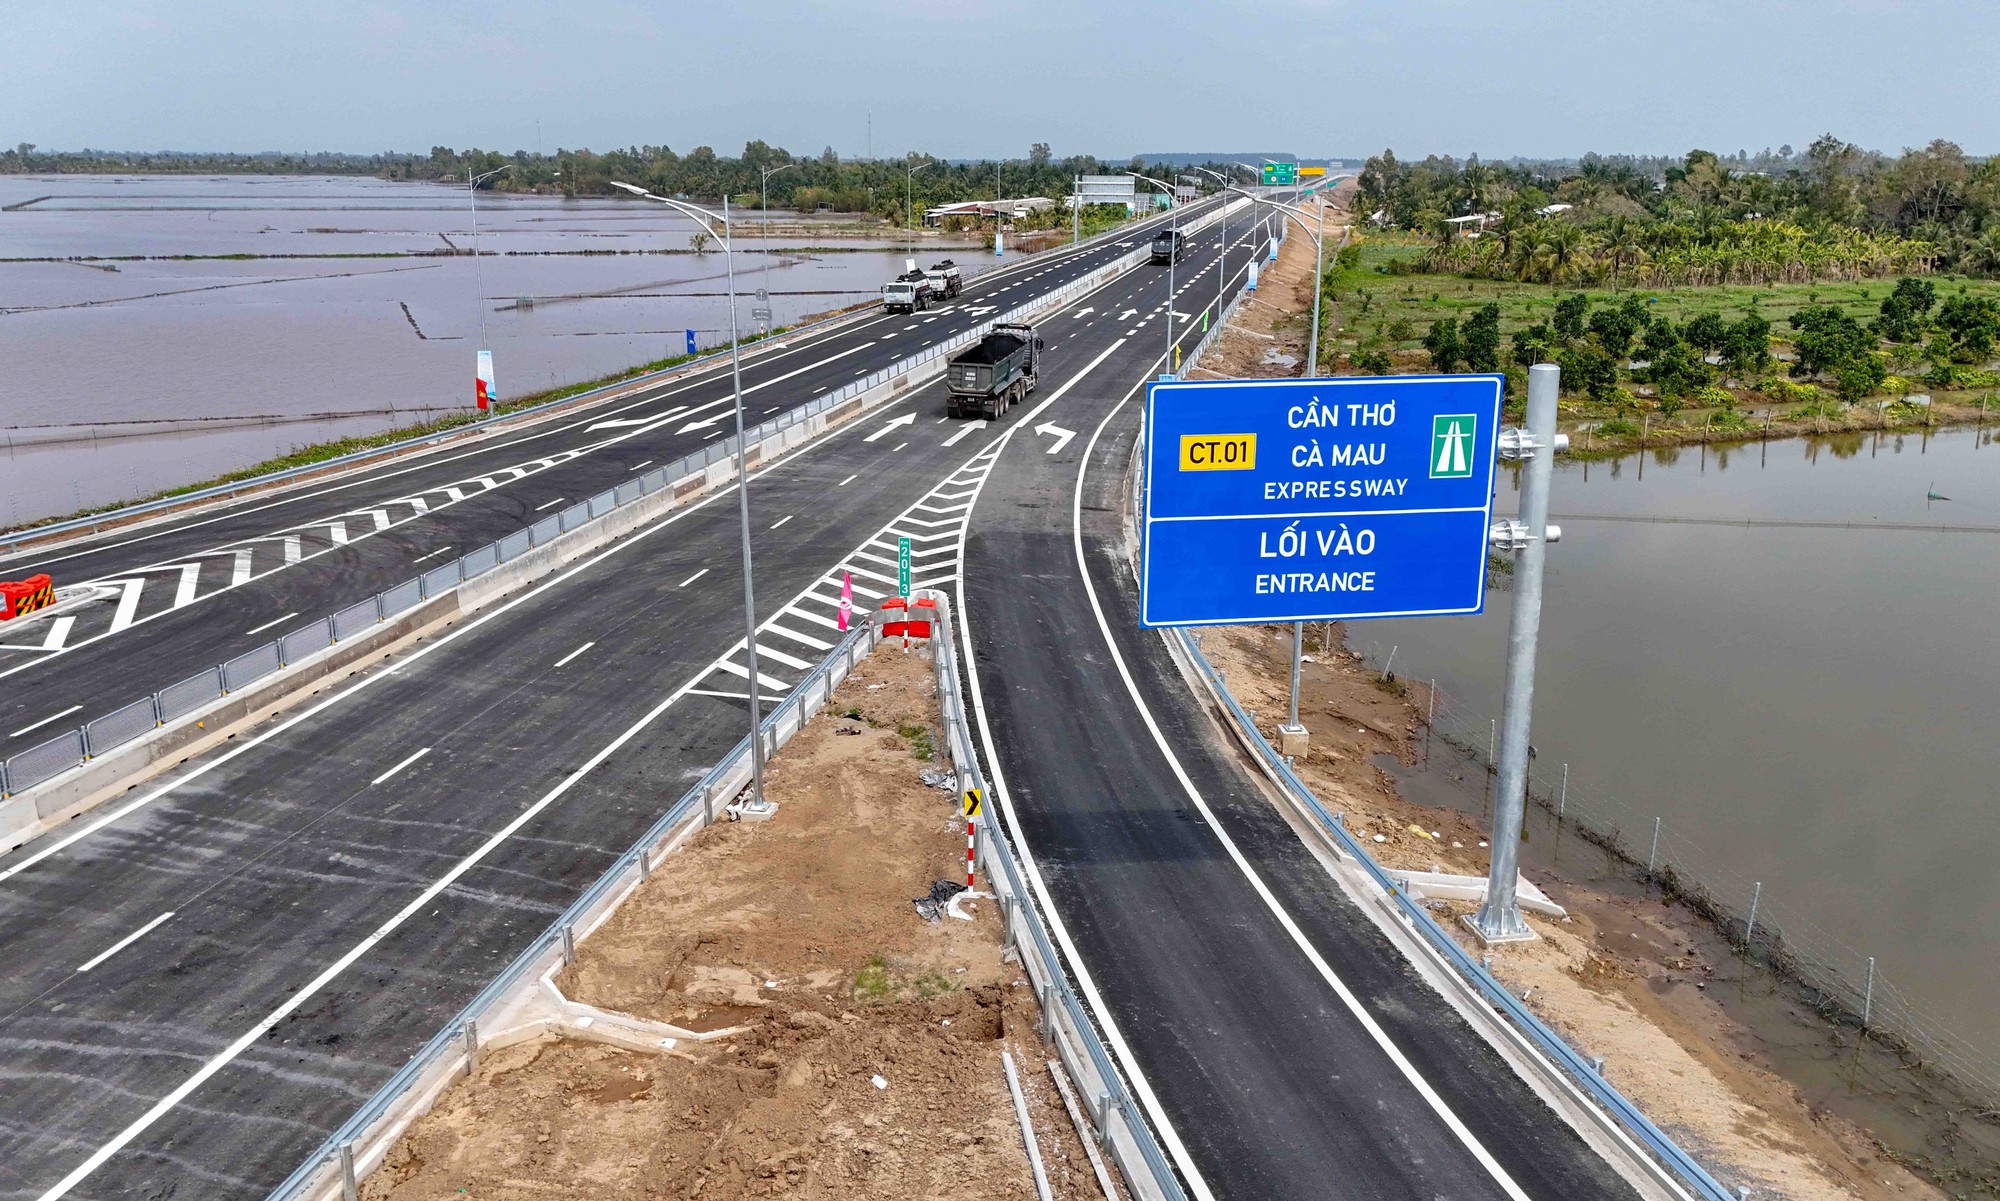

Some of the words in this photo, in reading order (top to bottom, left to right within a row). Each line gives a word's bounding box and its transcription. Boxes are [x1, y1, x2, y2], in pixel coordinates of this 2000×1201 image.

[1287, 395, 1339, 429] CẦN
[1346, 399, 1396, 427] THƠ
[1189, 440, 1248, 464] CT.01
[1291, 438, 1324, 467] CÀ
[1331, 443, 1386, 466] MAU
[1264, 478, 1408, 500] EXPRESSWAY
[1260, 519, 1307, 558] LỐI
[1315, 523, 1376, 556] VÀO
[1255, 571, 1376, 594] ENTRANCE
